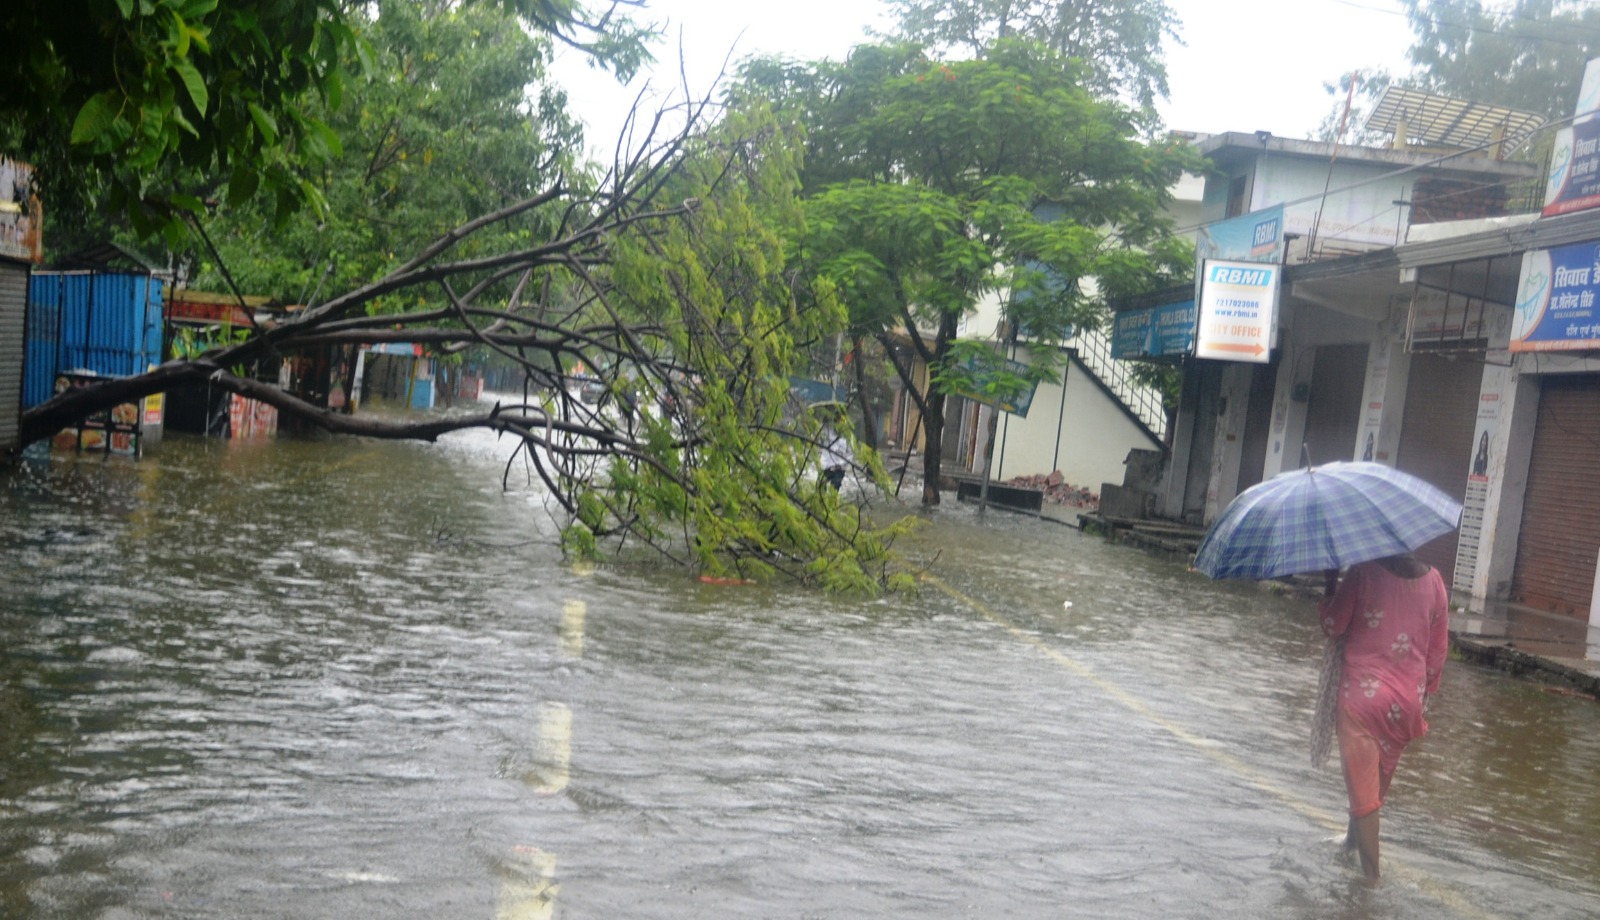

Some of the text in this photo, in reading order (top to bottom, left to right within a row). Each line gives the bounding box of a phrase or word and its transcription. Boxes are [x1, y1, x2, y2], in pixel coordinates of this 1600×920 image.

[1254, 220, 1277, 246] RBMI
[1214, 268, 1266, 286] RBMI
[1554, 266, 1591, 288] सिवाच
[1215, 309, 1258, 318] www.rbmi.in
[1231, 325, 1263, 337] OFFICE
